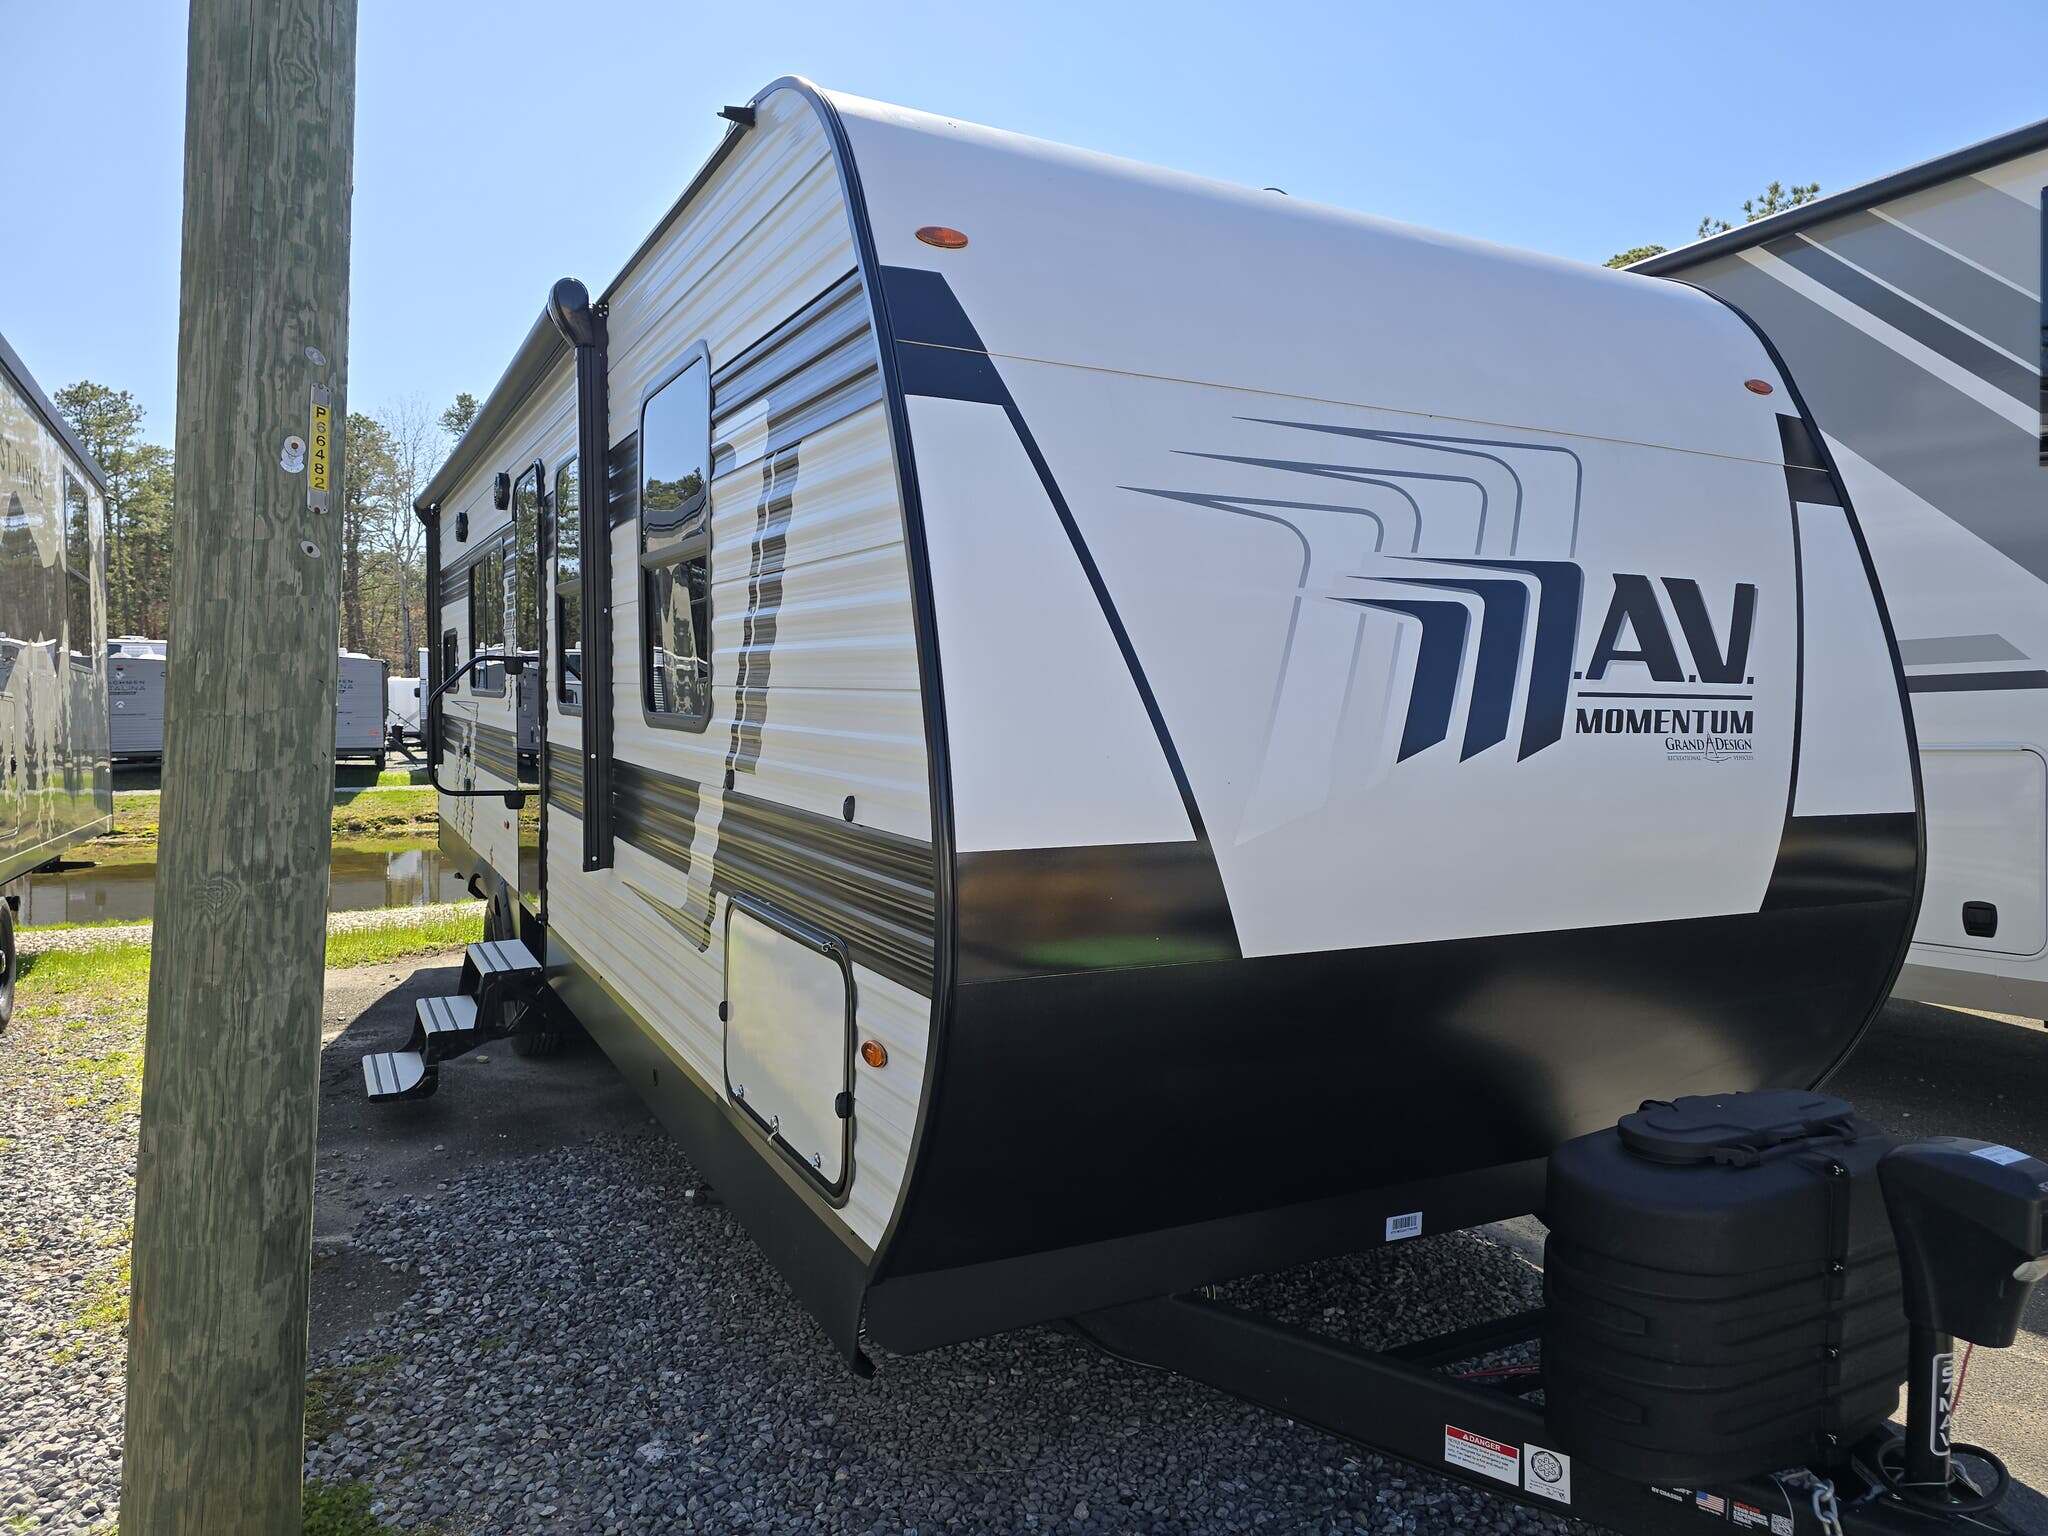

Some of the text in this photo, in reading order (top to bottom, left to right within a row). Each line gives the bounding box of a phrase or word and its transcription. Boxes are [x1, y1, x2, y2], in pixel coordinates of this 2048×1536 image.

[315, 406, 327, 490] P66482
[1575, 708, 1754, 734] MOMENTUM
[1665, 737, 1753, 751] GRAND DESIGN
[1469, 1434, 1501, 1452] DANGER
